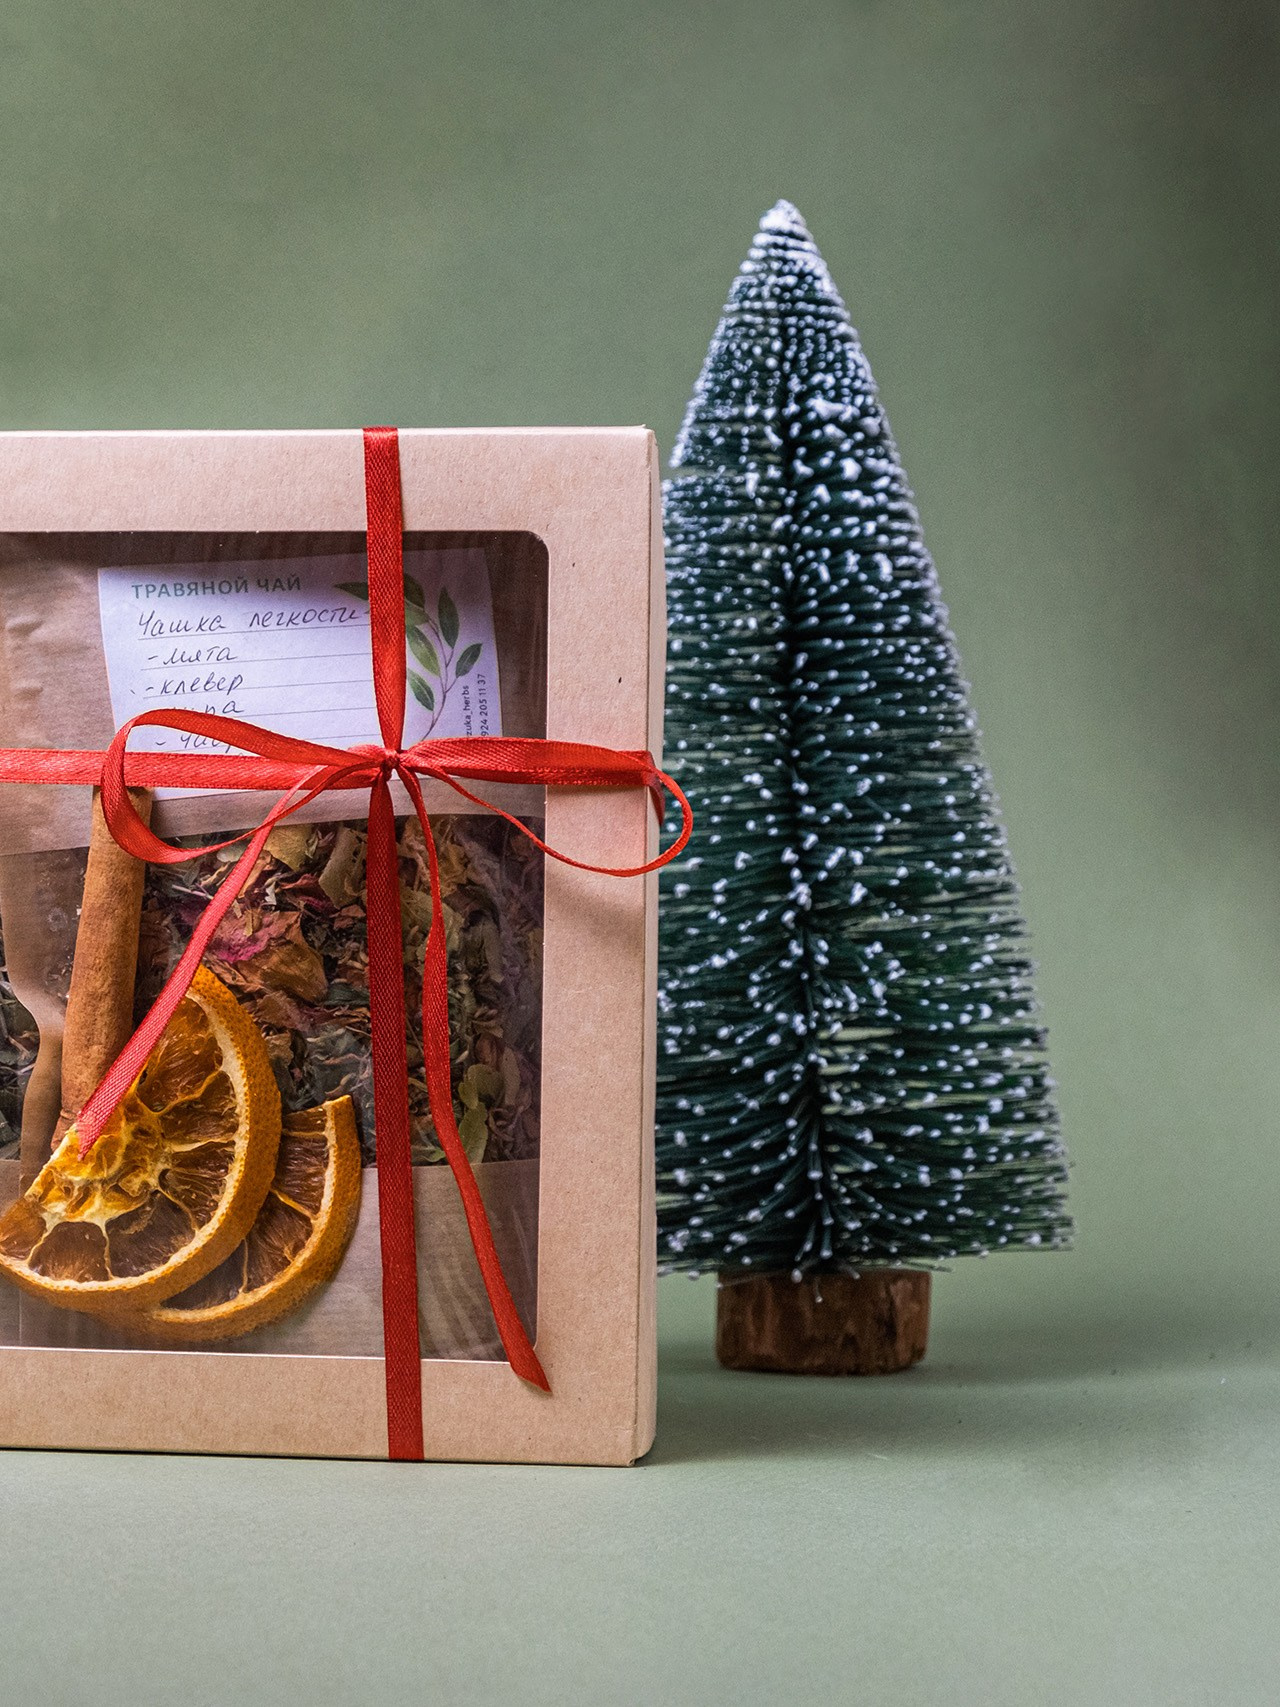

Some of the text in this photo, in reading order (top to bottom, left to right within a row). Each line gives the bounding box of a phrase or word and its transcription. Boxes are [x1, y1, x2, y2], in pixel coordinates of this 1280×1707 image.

[131, 576, 301, 600] ТРАВЯНОЙ ЧАЙ
[137, 610, 226, 637] Чашка
[477, 673, 486, 685] 37
[478, 688, 486, 696] 11
[479, 699, 488, 716] 205
